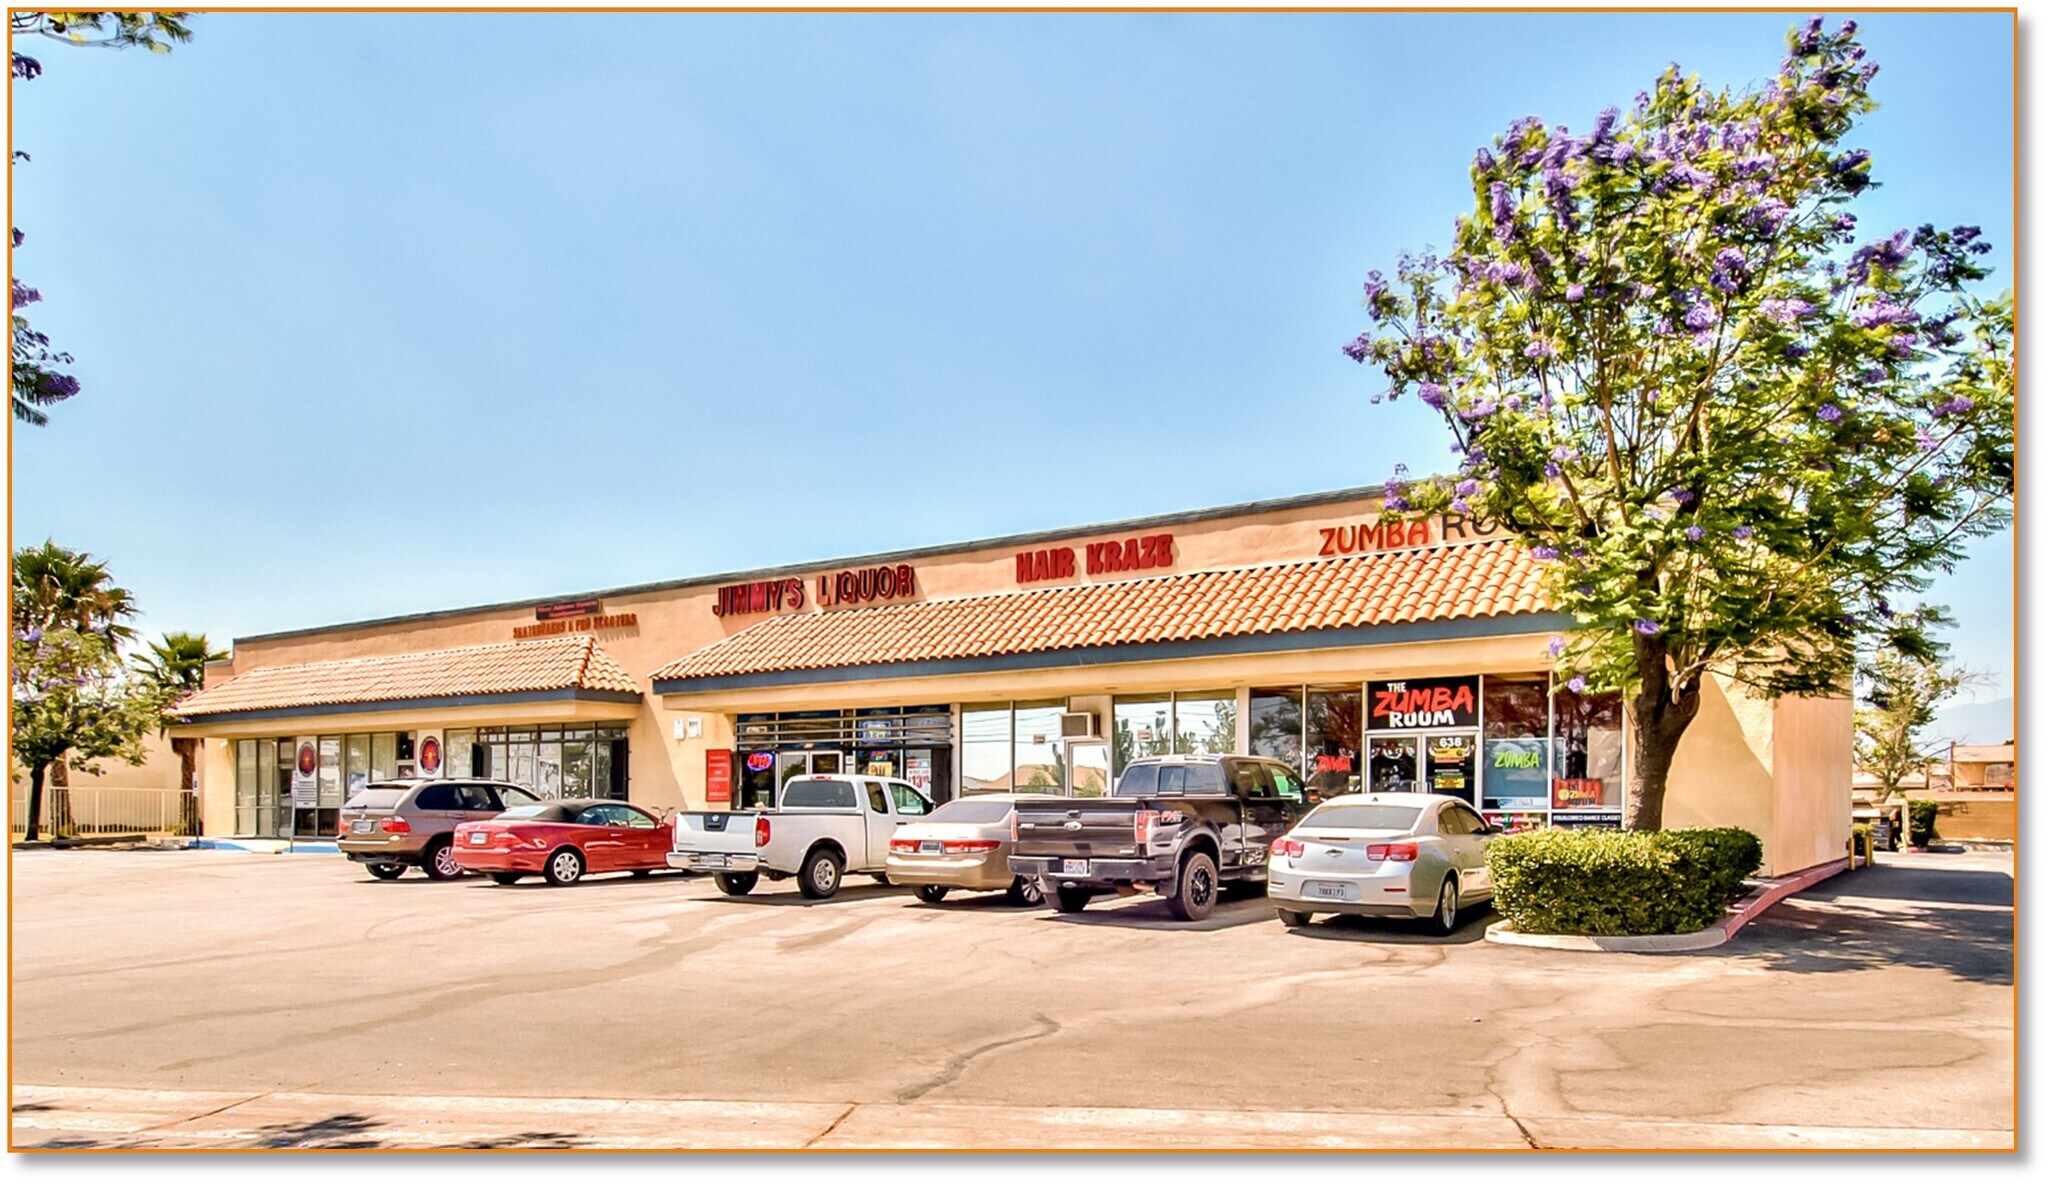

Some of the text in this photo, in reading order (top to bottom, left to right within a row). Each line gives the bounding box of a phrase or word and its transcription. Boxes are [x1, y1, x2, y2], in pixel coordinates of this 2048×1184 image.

[1318, 519, 1430, 556] ZUMBA
[1016, 534, 1173, 583] HAIR KRAZE
[712, 564, 915, 617] JIMMY'S LIQUOR
[1387, 682, 1407, 693] THE
[1373, 685, 1474, 718] ZUMBA
[1389, 709, 1455, 728] ROOM
[1439, 737, 1462, 747] 638
[1494, 751, 1541, 769] ZUMBA
